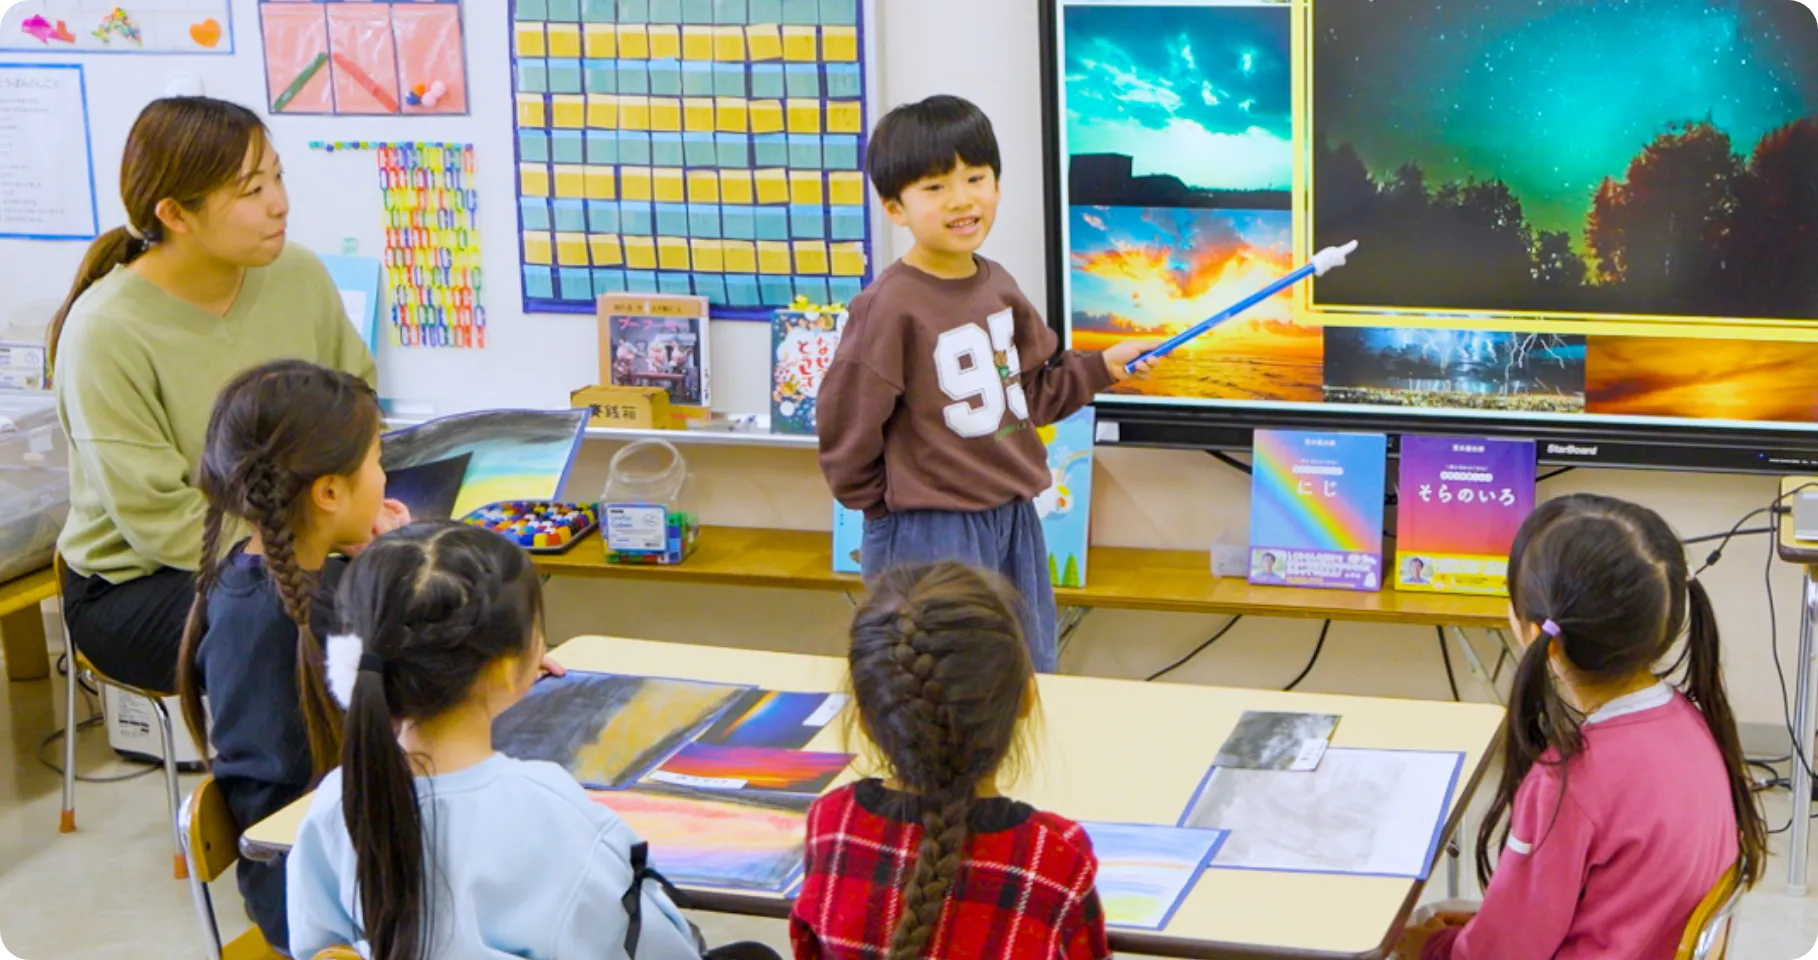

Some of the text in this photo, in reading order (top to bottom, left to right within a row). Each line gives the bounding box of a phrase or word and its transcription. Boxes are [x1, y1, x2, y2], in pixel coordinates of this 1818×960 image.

[1547, 444, 1598, 455] StarBoard
[1297, 479, 1337, 497] にじ
[1418, 483, 1515, 506] そらのいろ
